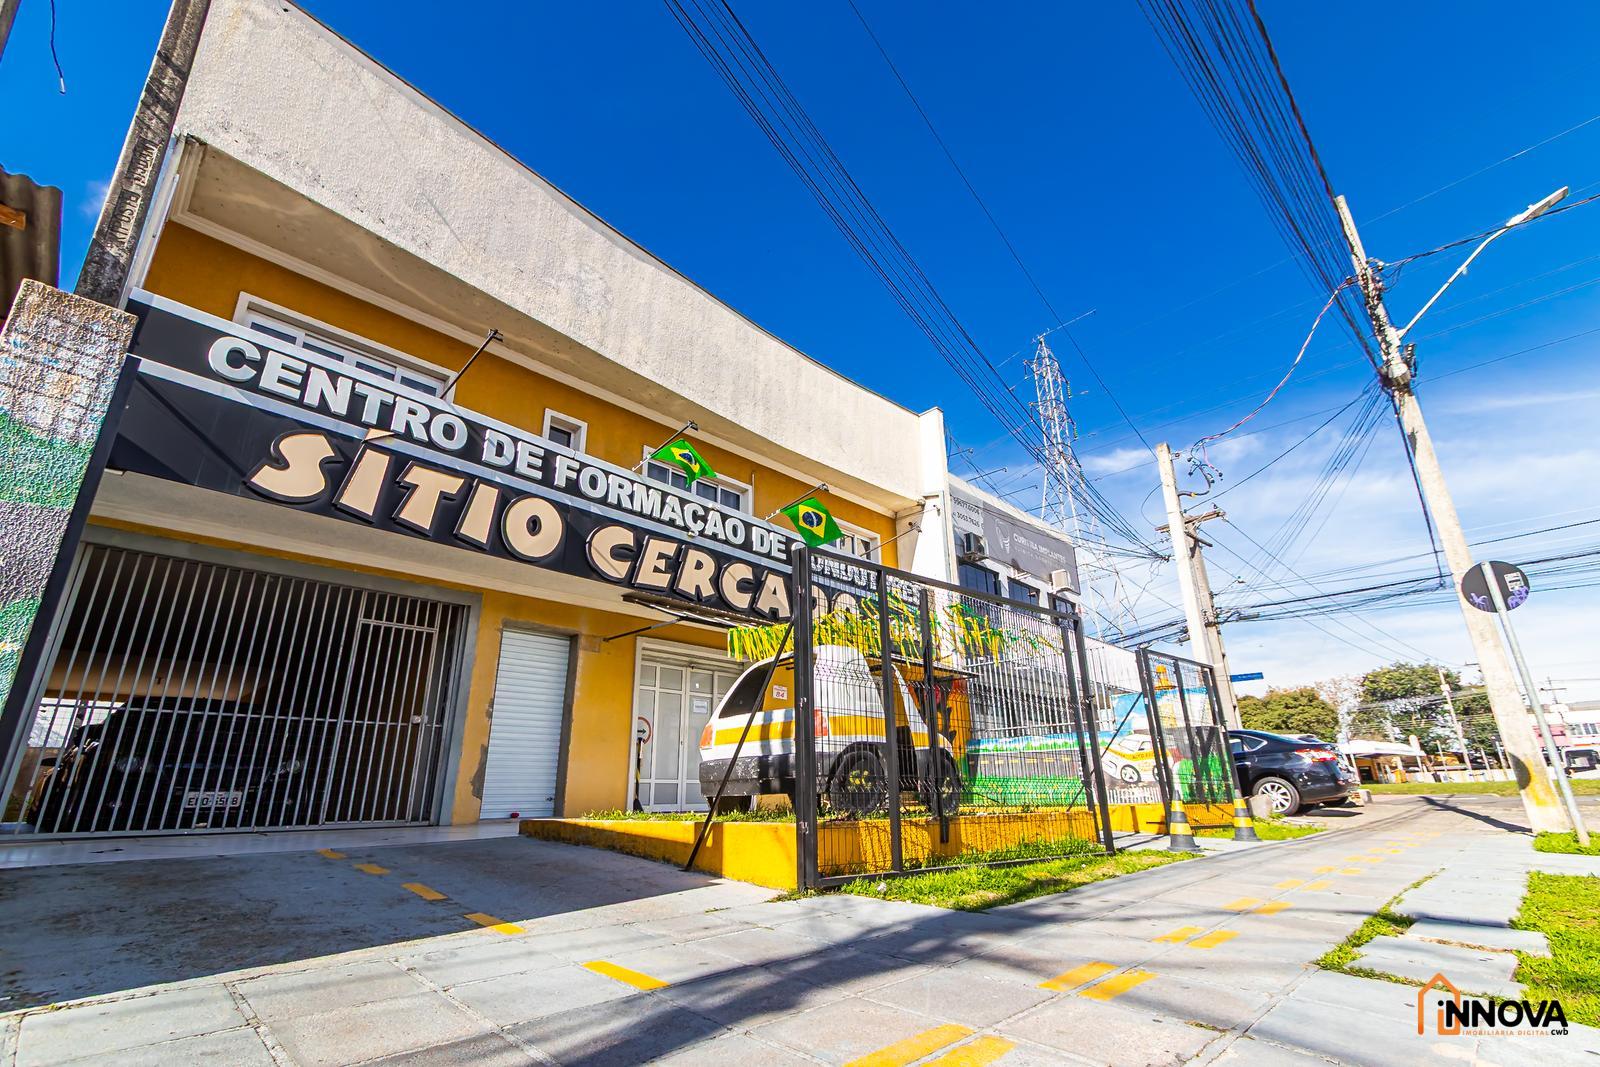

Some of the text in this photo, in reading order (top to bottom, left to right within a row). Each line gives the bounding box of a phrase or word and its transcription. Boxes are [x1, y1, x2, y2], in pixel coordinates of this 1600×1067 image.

[207, 336, 468, 451] CENTRO
[482, 429, 545, 481] DE
[554, 454, 746, 546] FORMAÇÃO
[752, 525, 788, 562] DE
[242, 427, 566, 563] SÍTIO
